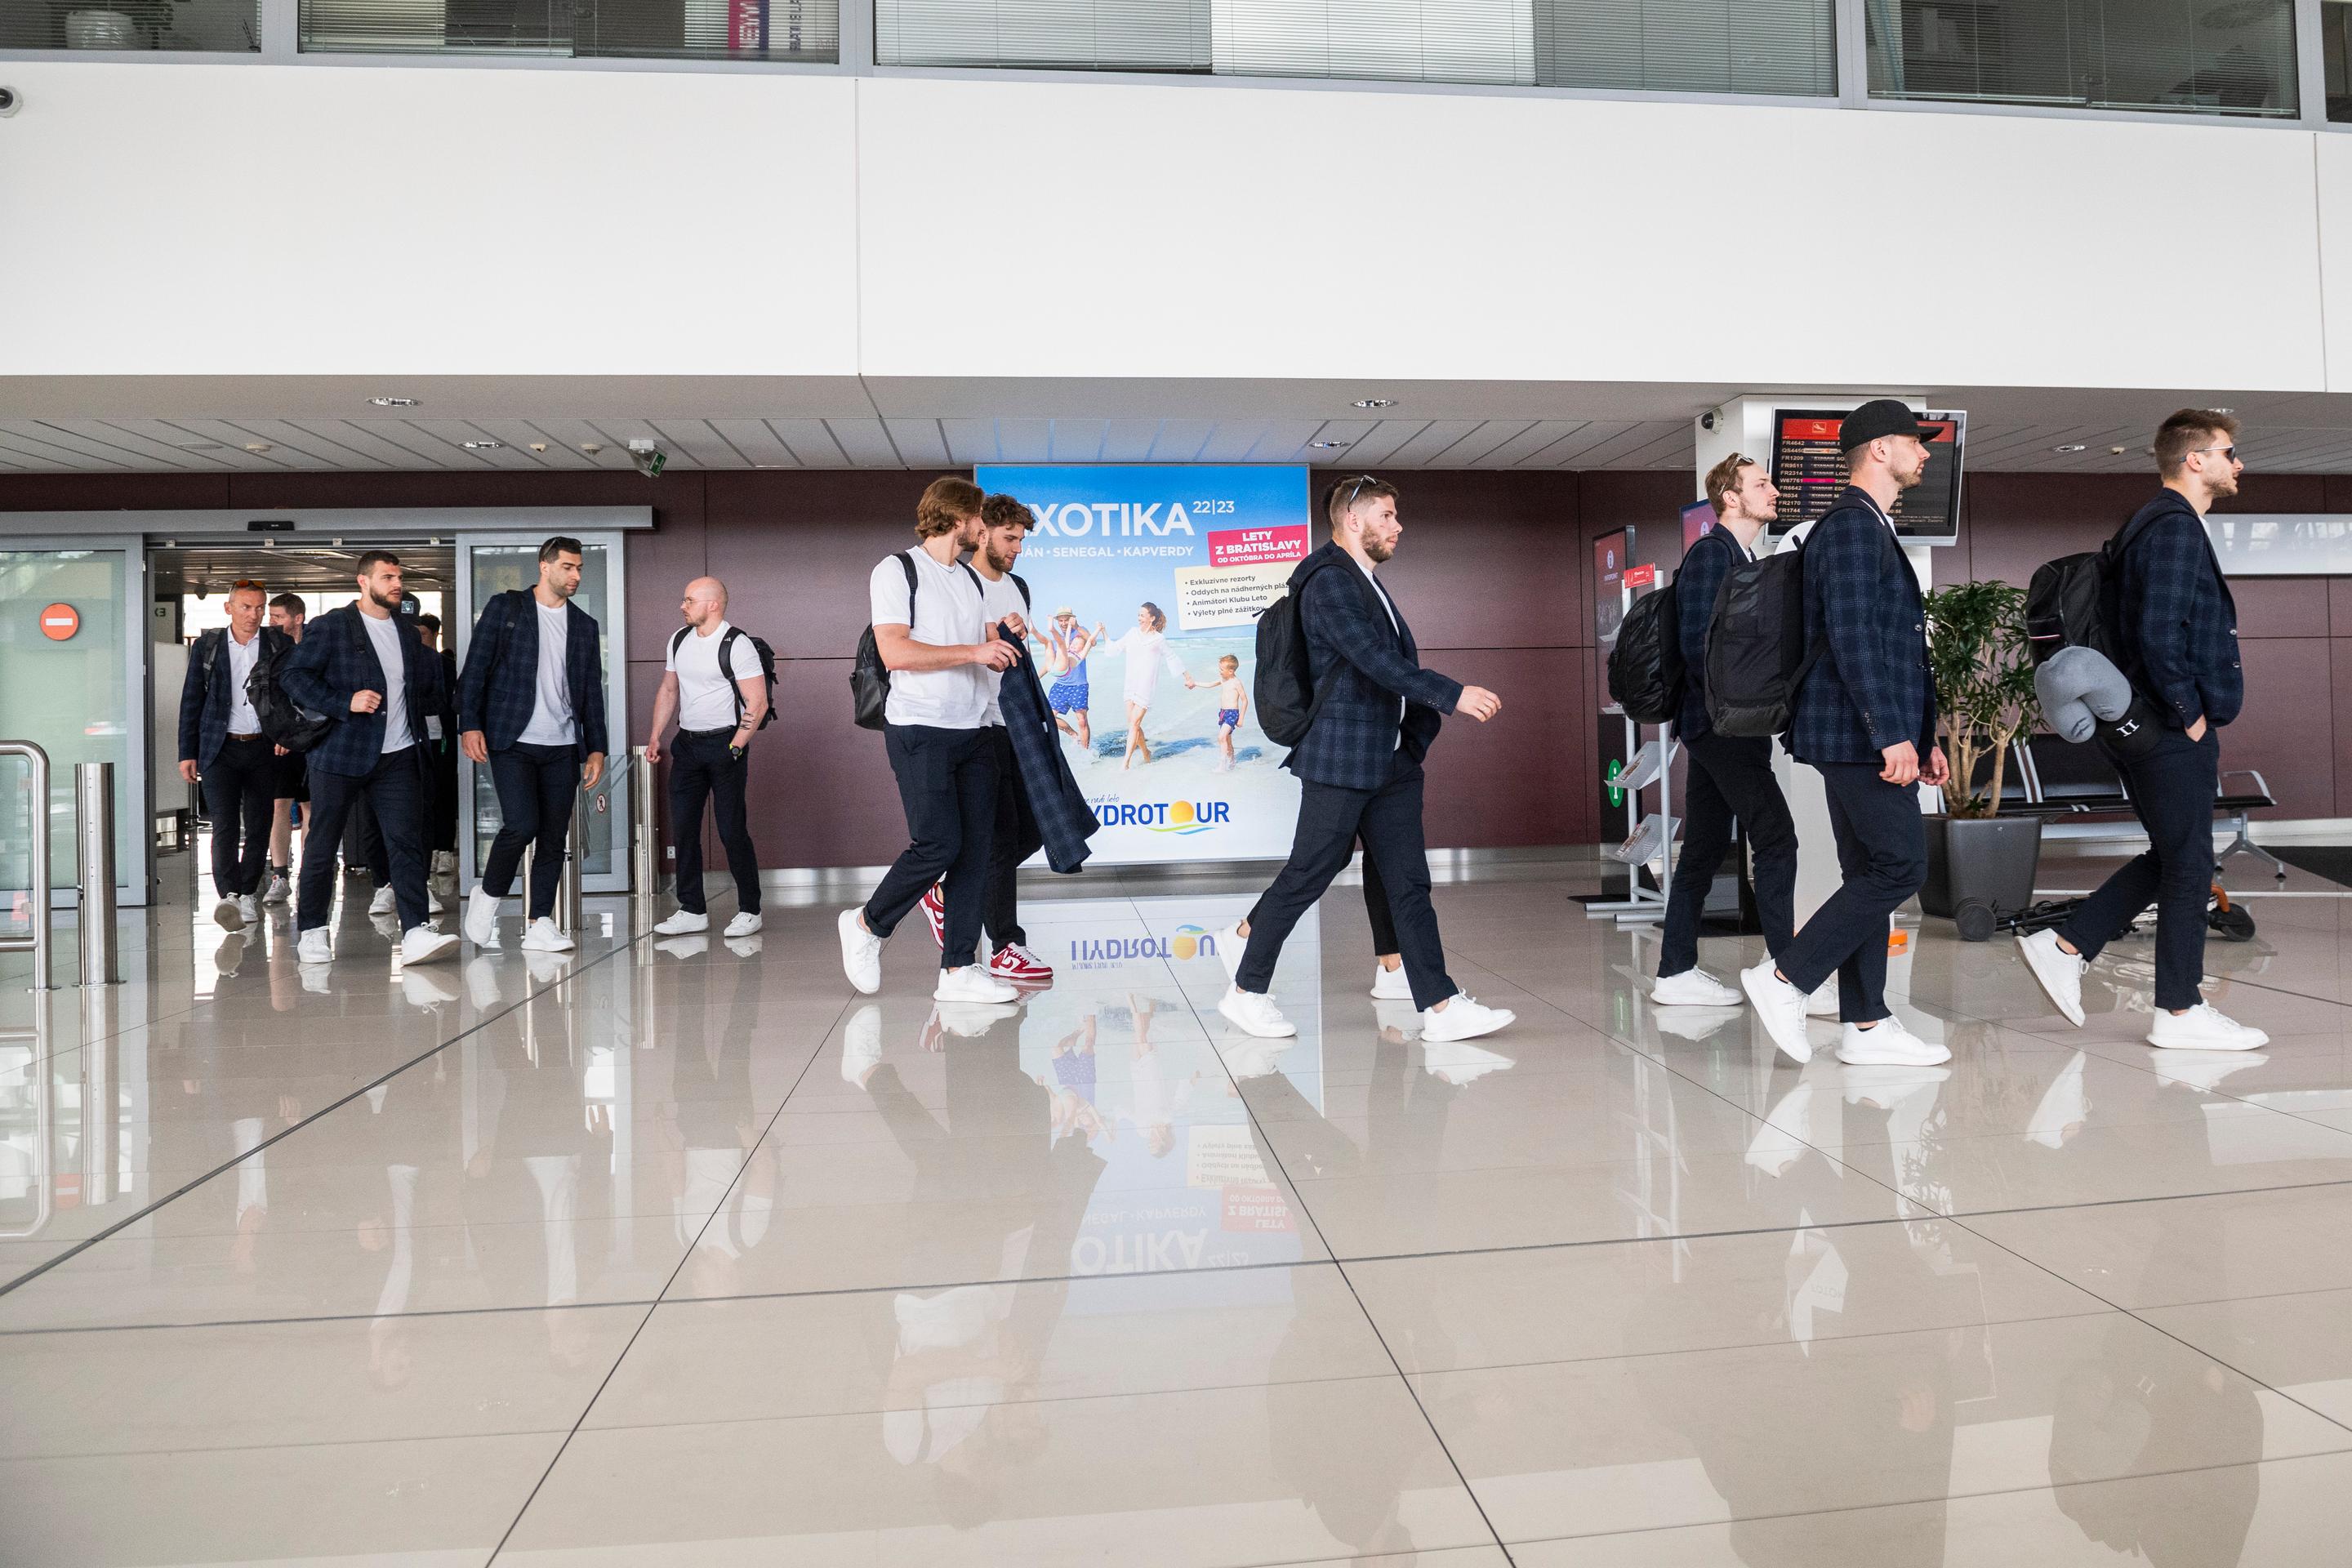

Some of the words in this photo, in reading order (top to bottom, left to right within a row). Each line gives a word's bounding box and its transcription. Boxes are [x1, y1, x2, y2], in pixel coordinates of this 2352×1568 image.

[1024, 502, 1196, 537] XOTIKA
[1242, 530, 1273, 542] LETY
[1021, 546, 1044, 557] ÁN
[1053, 546, 1115, 558] SENEGAL
[1124, 546, 1195, 557] KAPVERDY
[1215, 546, 1224, 555] Z
[1226, 540, 1302, 555] BRATISLAVY
[1229, 553, 1263, 563] OKTÓBRA
[1276, 550, 1302, 559] APRÍLA
[1190, 577, 1228, 586] Exkluzívne
[1230, 575, 1256, 583] rezorty
[1191, 587, 1219, 596] Oddych
[1231, 582, 1273, 593] nádherných
[1192, 597, 1227, 606] Animátori
[1192, 608, 1216, 617] Výlety
[1218, 606, 1232, 615] plné
